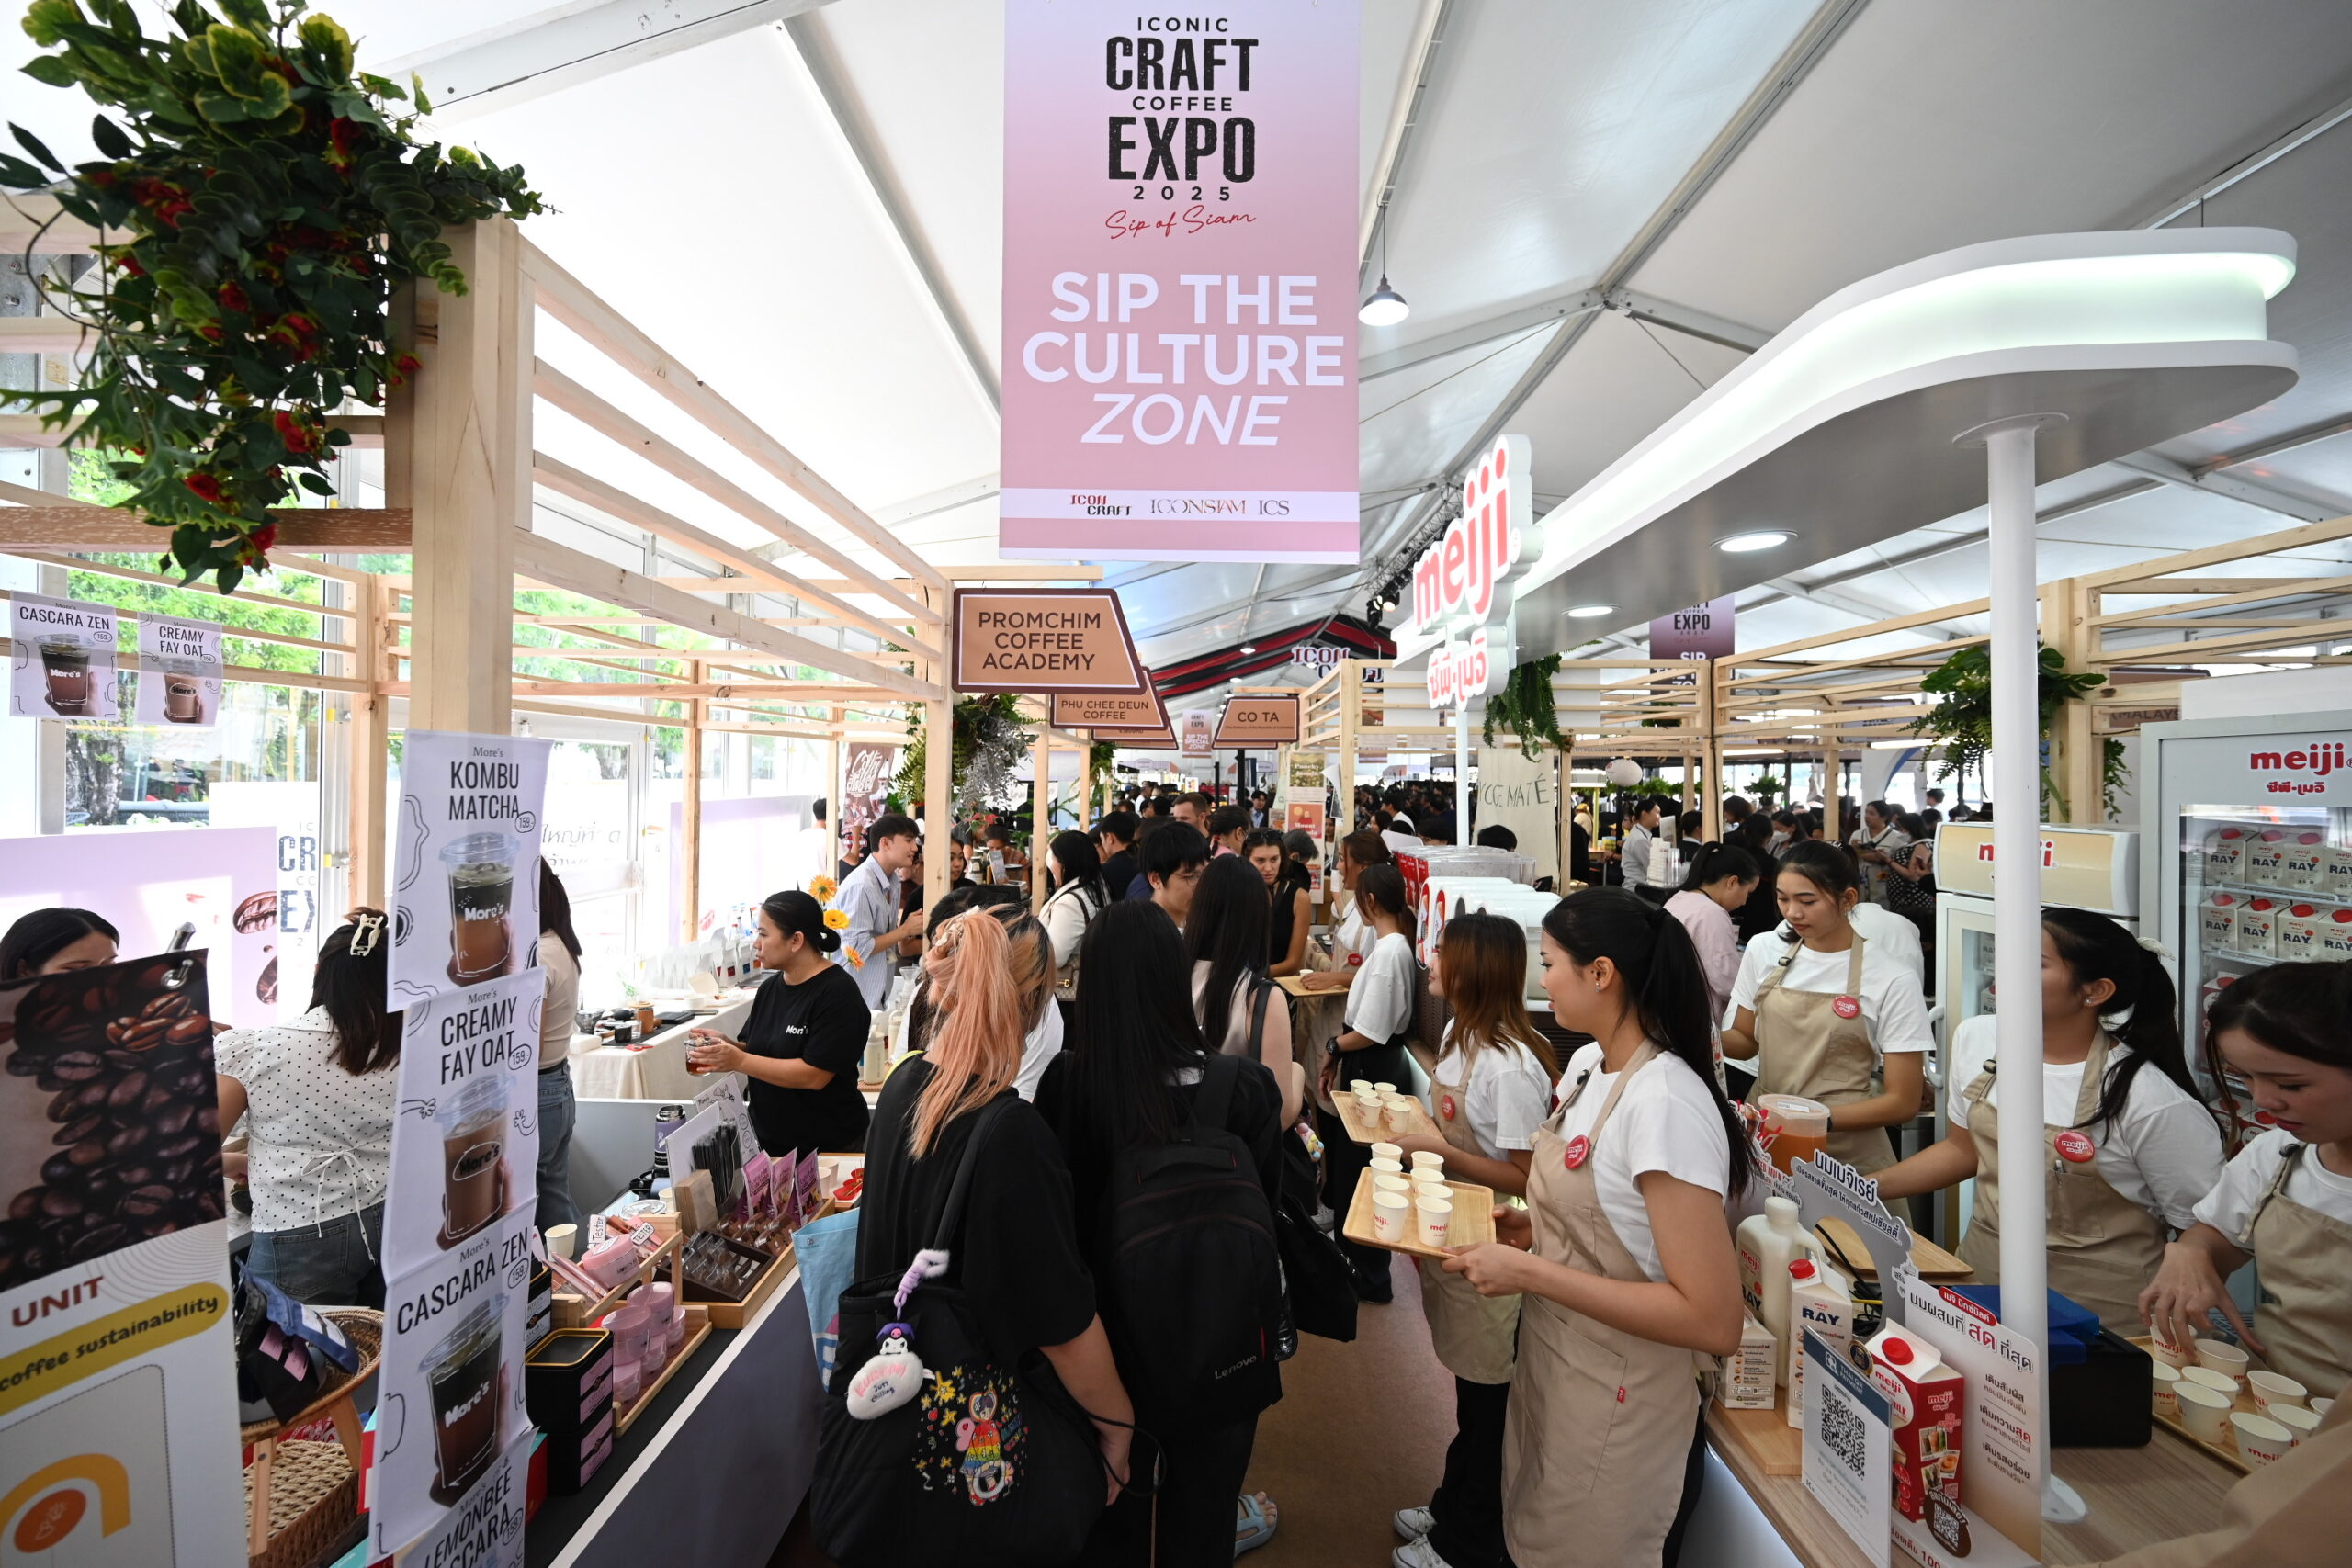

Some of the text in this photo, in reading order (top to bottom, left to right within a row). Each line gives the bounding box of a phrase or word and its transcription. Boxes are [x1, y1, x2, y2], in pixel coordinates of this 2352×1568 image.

[1137, 17, 1228, 32] ICONIC
[1106, 36, 1259, 92] CRAFT
[1132, 96, 1233, 112] COFFEE
[1108, 117, 1255, 183] EXPO
[1133, 186, 1230, 201] 2025
[1105, 204, 1256, 240] Sip of Siam
[1050, 271, 1317, 326] SIP THE
[1023, 331, 1344, 386] CULTURE
[1080, 393, 1289, 445] ZONE
[1070, 494, 1107, 505] ICON
[1150, 499, 1247, 514] ICONSIAM
[1259, 500, 1290, 516] ICS
[1087, 504, 1132, 516] CRAFT
[1416, 448, 1508, 626] meiji
[19, 606, 110, 630] CASCARA ZEN
[978, 612, 1101, 629] PROMCHIM
[1674, 615, 1710, 630] EXPO
[159, 626, 204, 642] CREAMY
[994, 632, 1083, 649] COFFEE
[160, 640, 203, 657] FAY OAT
[1293, 648, 1349, 663] ICON
[1680, 651, 1706, 660] SIP
[982, 653, 1095, 671] ACADEMY
[1430, 637, 1487, 702] ซีพี-เมจิ
[50, 668, 81, 678] More's
[172, 685, 197, 694] More's
[1061, 700, 1148, 710] PHU CHEE DEUN
[1083, 711, 1126, 720] COFFEE
[1238, 712, 1279, 722] CO TA
[473, 747, 503, 759] More's
[2250, 742, 2344, 775] meiji
[450, 761, 519, 790] KOMBU
[1507, 773, 1550, 807] MATÉ
[2266, 781, 2325, 795] ซีพี-เมจิ
[448, 795, 519, 821] MATCHA
[2211, 855, 2236, 863] RAY
[2252, 858, 2278, 867] RAY
[2289, 862, 2316, 871] RAY
[464, 902, 504, 922] More's
[2205, 921, 2230, 931] RAY
[2243, 927, 2267, 937] RAY
[2283, 933, 2312, 944] RAY
[468, 988, 498, 1005] More's
[441, 997, 517, 1047] CREAMY
[441, 1030, 515, 1085] FAY OAT
[2061, 1140, 2088, 1150] meiji
[458, 1145, 501, 1176] More's
[1815, 1151, 1875, 1202] นมเมจิเรย์
[592, 1216, 605, 1242] Tester
[632, 1224, 651, 1242] TESTER
[459, 1236, 491, 1263] More's
[1741, 1249, 1760, 1271] meiji
[396, 1226, 528, 1335] CASCARA ZEN
[12, 1276, 104, 1328] UNIT
[1802, 1307, 1840, 1326] RAY
[1910, 1292, 2032, 1371] นมผสมที่ สด ที่สุด
[0, 1294, 219, 1392] coffee sustainability
[1215, 1355, 1257, 1380] Lenovo
[1875, 1371, 1902, 1393] meiji
[445, 1379, 490, 1428] More's
[1928, 1390, 1954, 1404] meiji
[425, 1466, 512, 1568] LEMONBEE
